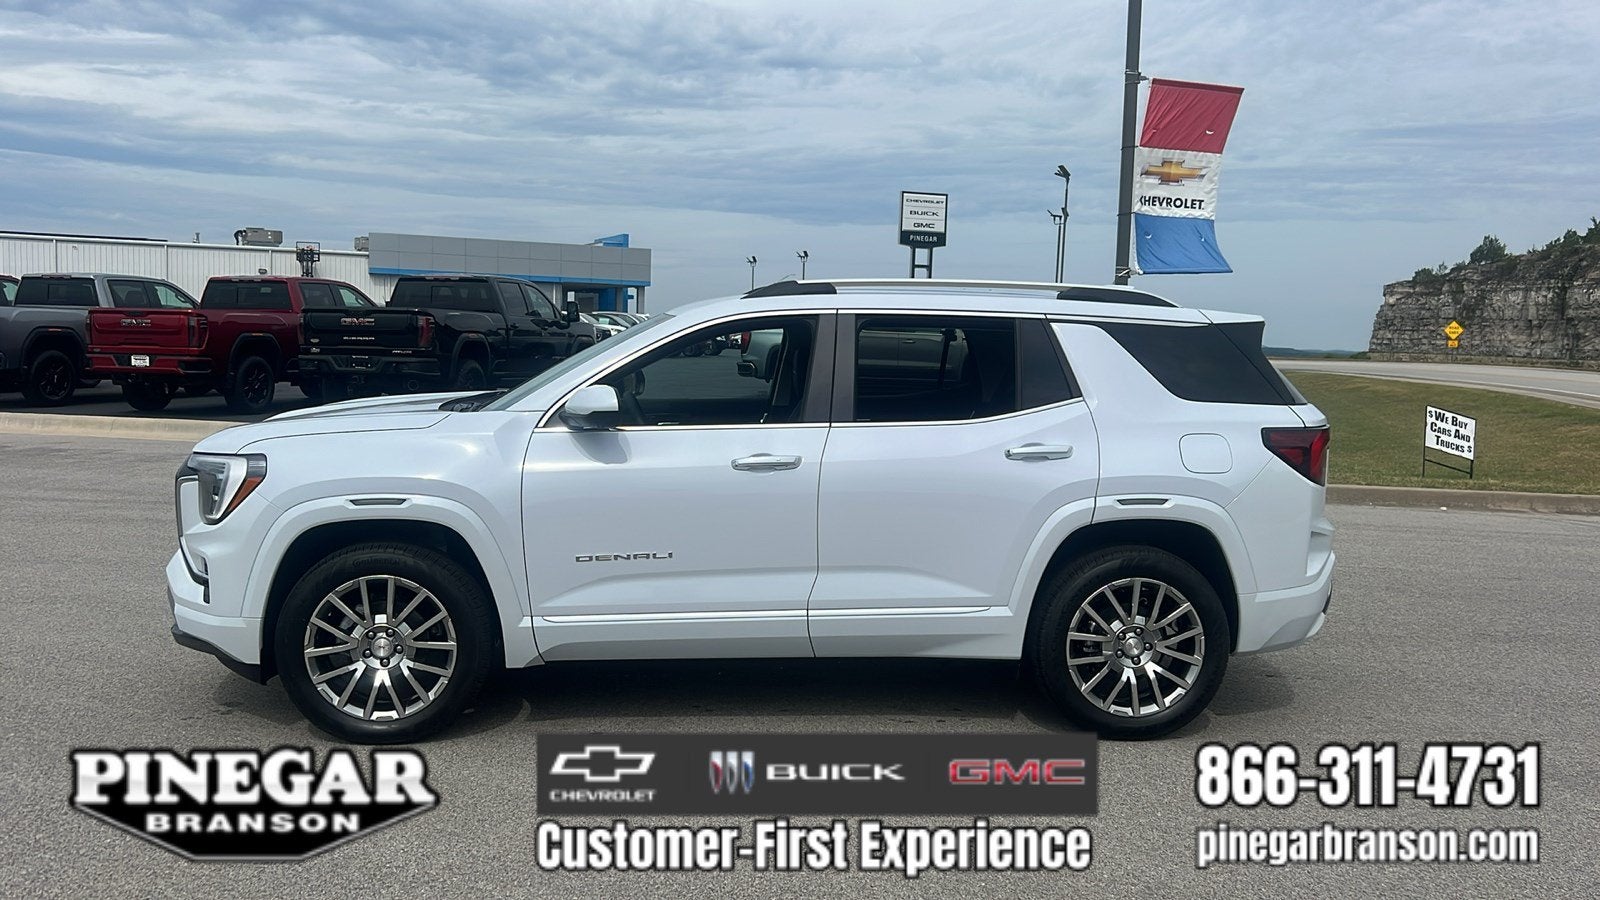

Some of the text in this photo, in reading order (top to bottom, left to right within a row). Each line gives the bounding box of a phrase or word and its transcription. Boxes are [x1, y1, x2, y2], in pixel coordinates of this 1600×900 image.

[909, 234, 938, 242] PINEGAR
[341, 317, 375, 326] GMC
[575, 551, 672, 562] DENALI
